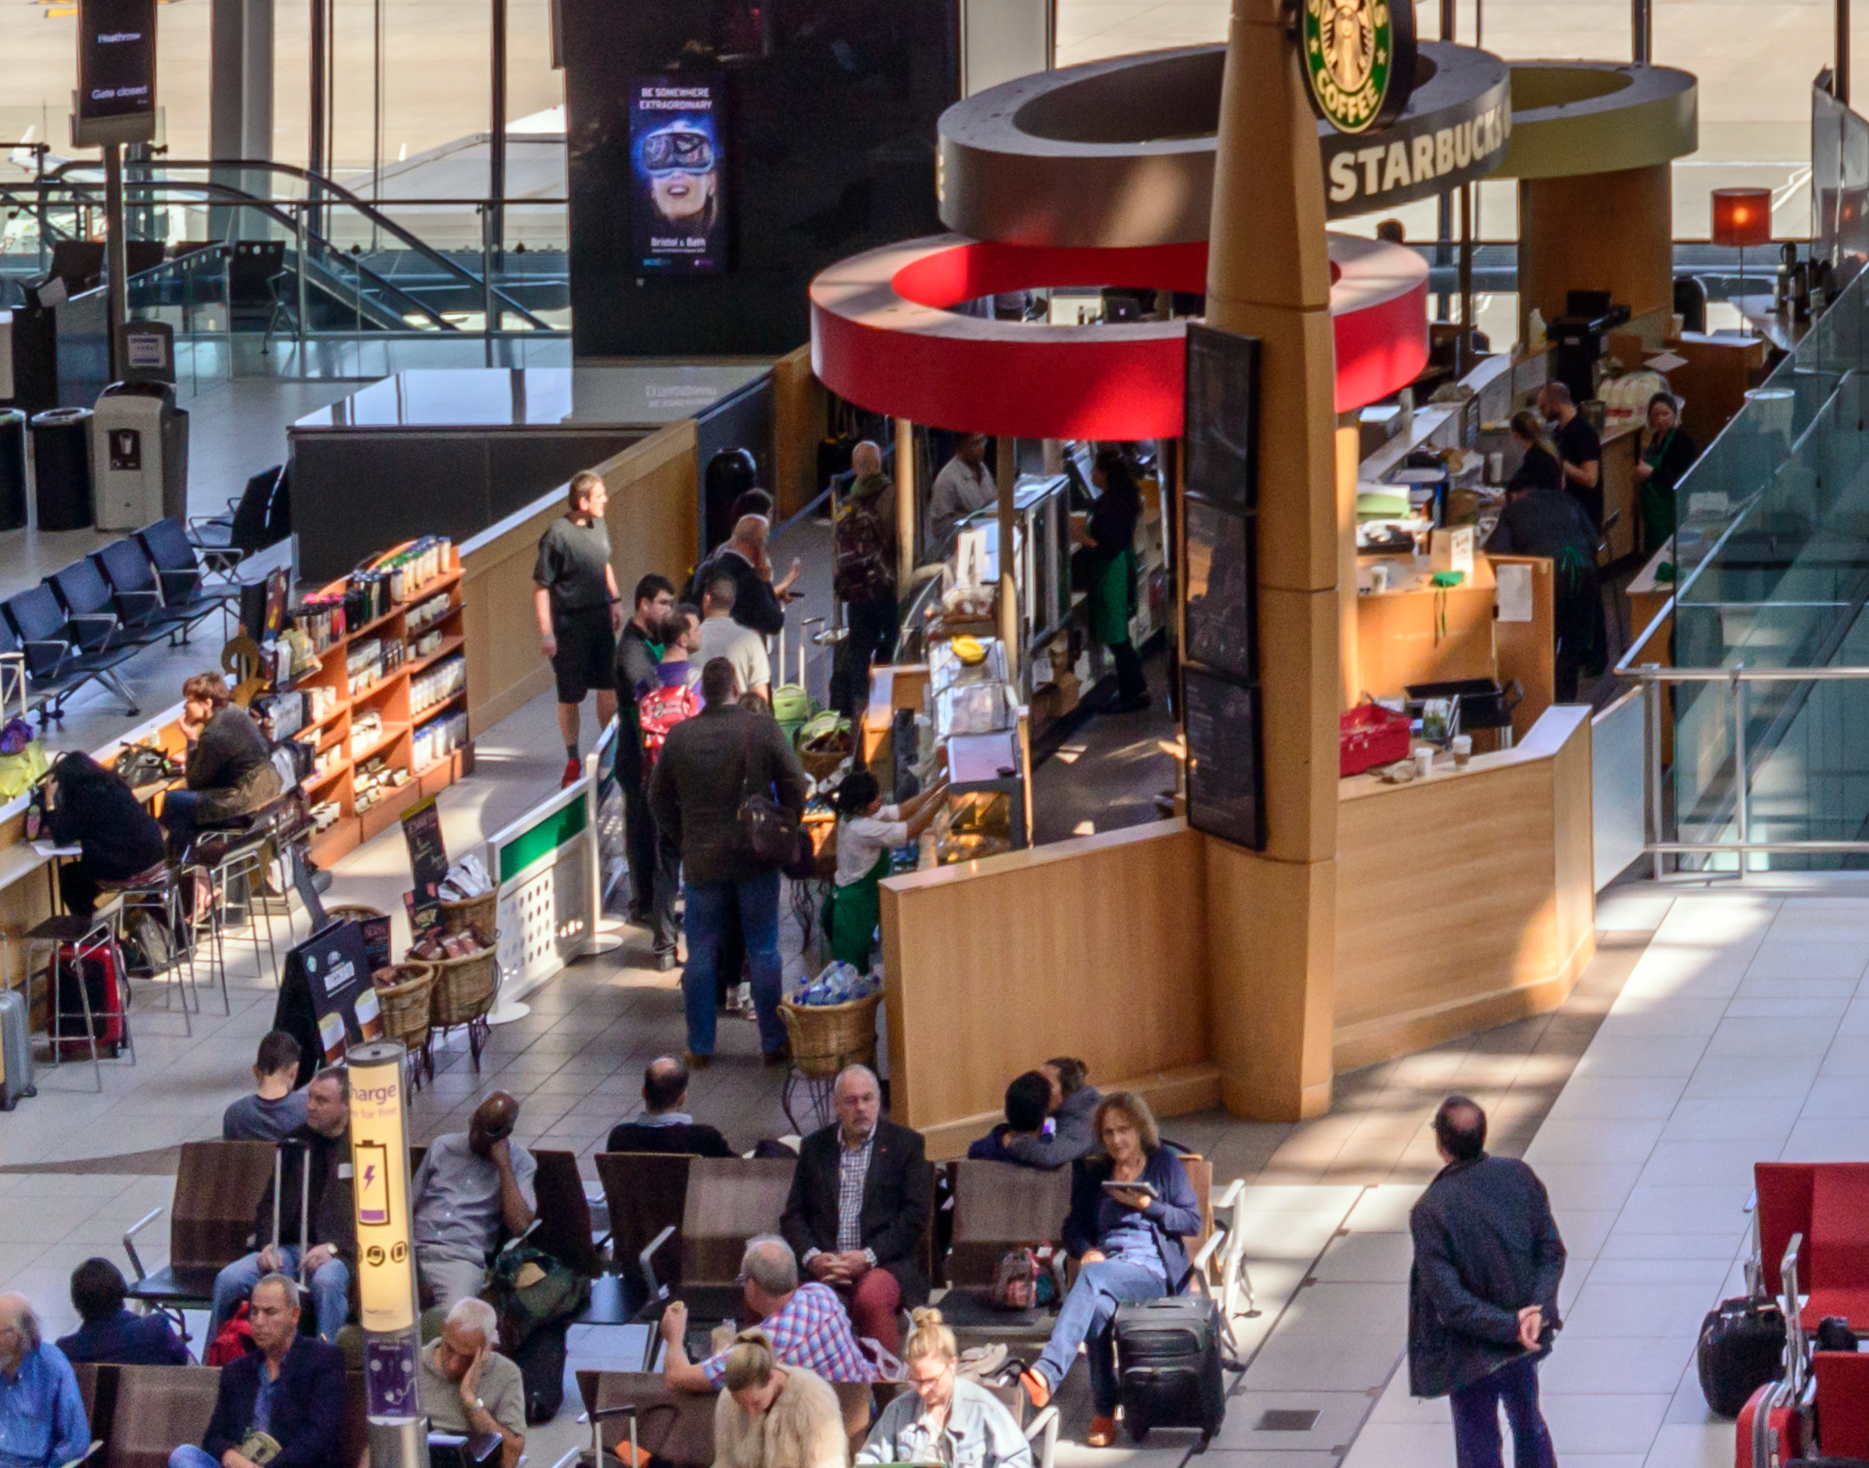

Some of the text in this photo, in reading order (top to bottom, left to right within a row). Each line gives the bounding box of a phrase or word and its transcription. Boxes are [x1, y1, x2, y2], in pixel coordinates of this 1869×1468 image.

[91, 85, 147, 100] Gate closed
[639, 100, 713, 110] EXTRAORDINARY
[1316, 67, 1379, 124] COFFEE
[1329, 103, 1503, 202] STARBUCKS
